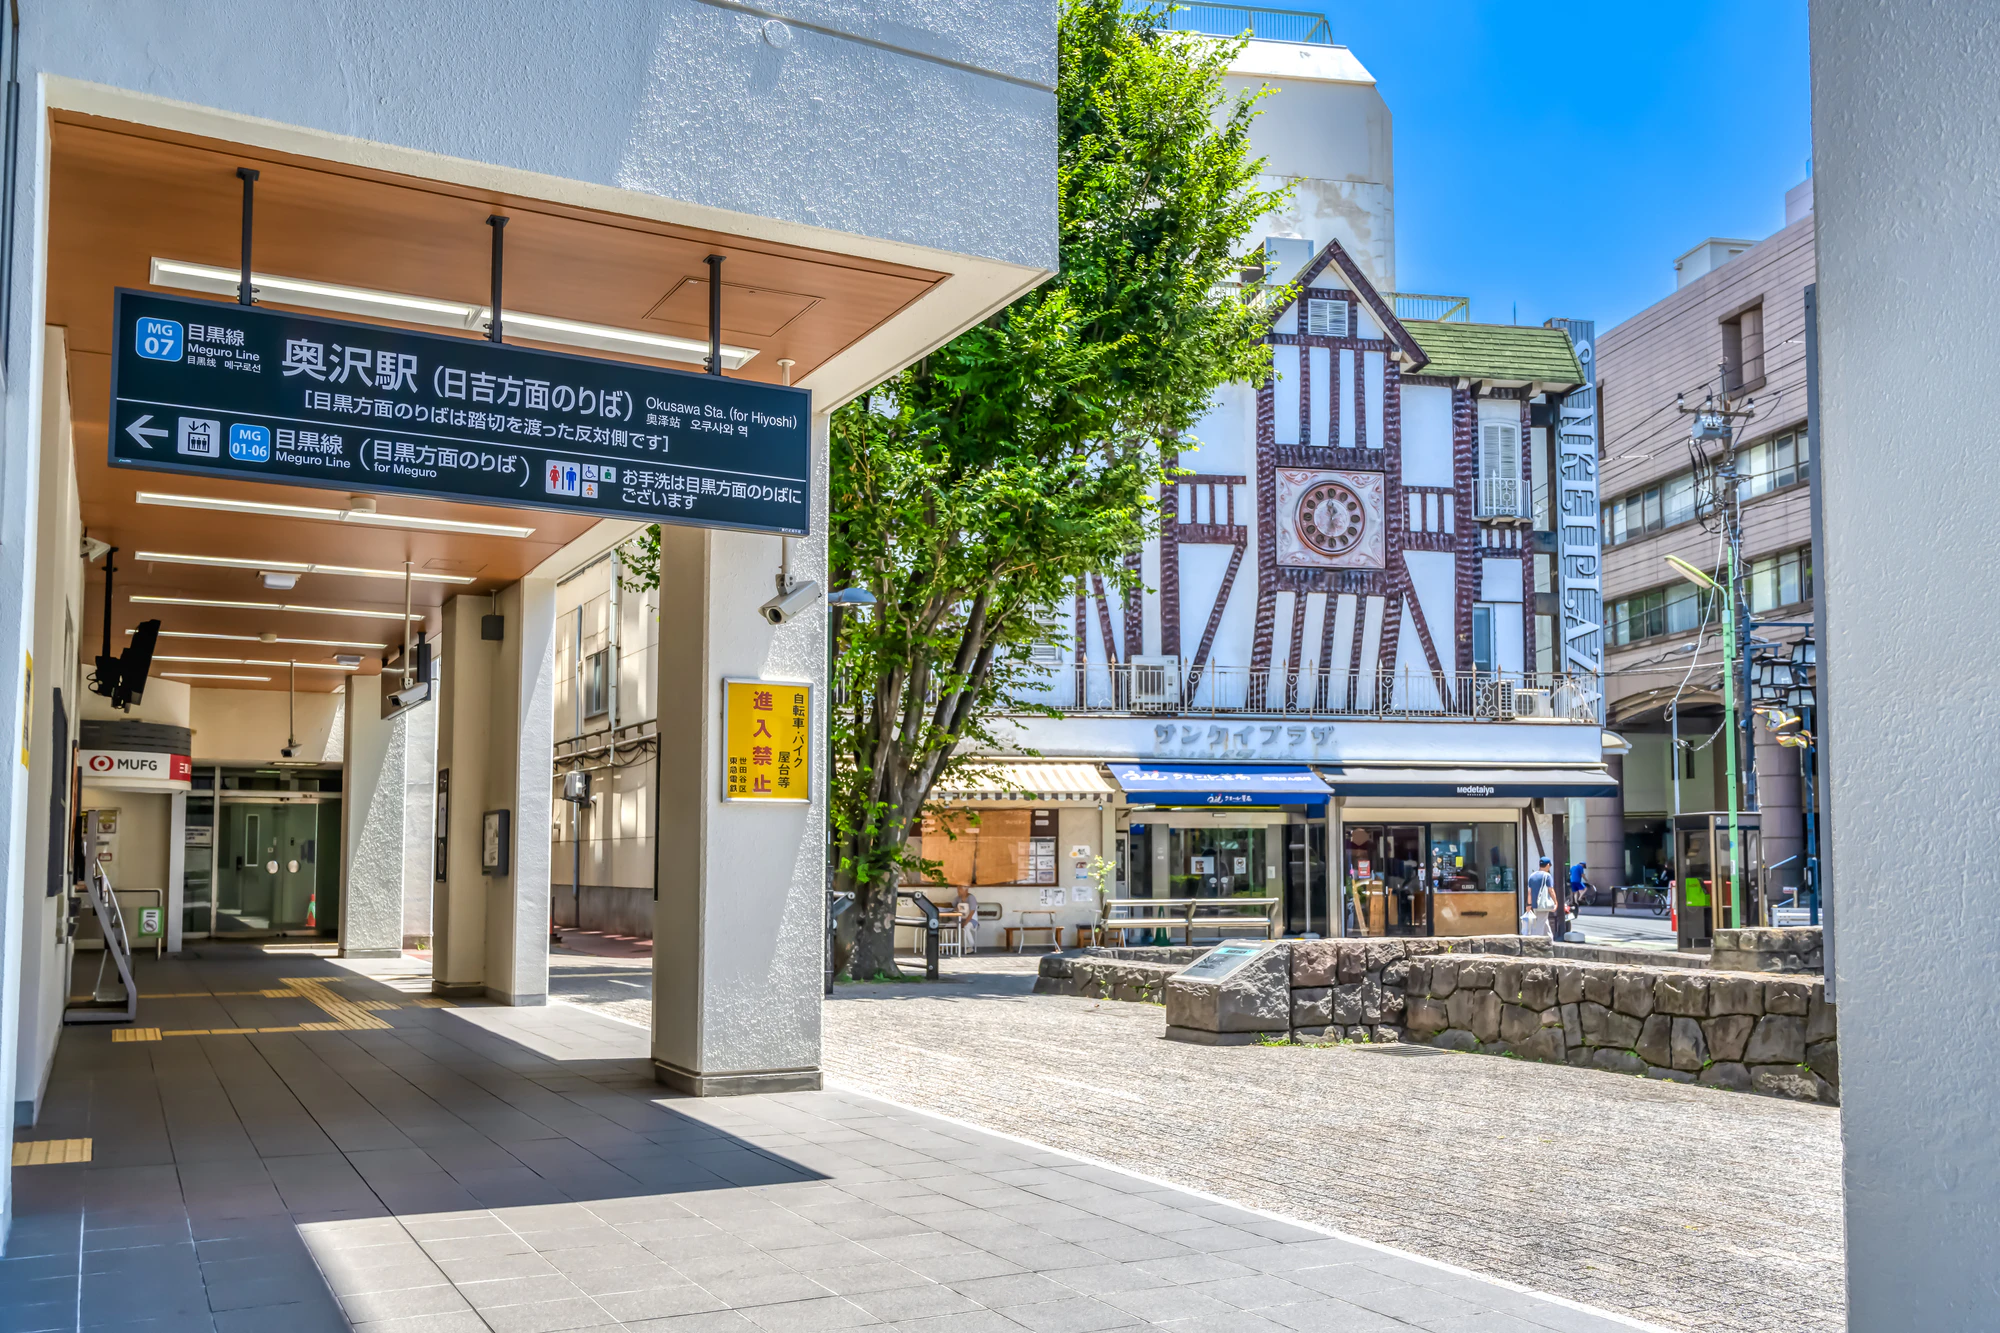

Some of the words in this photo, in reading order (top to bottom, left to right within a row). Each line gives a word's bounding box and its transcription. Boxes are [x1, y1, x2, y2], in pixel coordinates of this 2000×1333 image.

[147, 321, 174, 337] MG
[188, 323, 245, 347] 目黒線
[143, 336, 175, 357] 07
[188, 343, 233, 358] Meguro
[235, 348, 260, 362] Line
[224, 360, 261, 374] 메구로선
[282, 338, 418, 394] 奥沢駅
[433, 365, 633, 422] (日吉方面のりば)
[304, 389, 669, 453] [目黒方面のりばは踏切を渡った反対側です]
[646, 396, 701, 417] Okusawa
[704, 404, 727, 419] Sta.
[729, 406, 749, 422] (for
[751, 411, 797, 430] Hiyoshi)
[239, 429, 262, 442] MG
[690, 419, 734, 436] 오쿠사와
[737, 426, 748, 438] 역
[1560, 340, 1597, 530] SNKEI
[232, 442, 268, 458] 01-06
[275, 428, 344, 455] 目黒線
[275, 451, 322, 466] Meguro
[325, 456, 351, 469] Line
[373, 462, 391, 473] for
[393, 464, 438, 478] Meguro
[622, 469, 802, 504] お手洗は目黒方面のりばに
[622, 488, 698, 510] ございます
[752, 690, 773, 793] 進入禁止
[792, 693, 806, 768] 自転車・バイク
[1154, 723, 1336, 747] サンケイプラザ
[117, 758, 158, 771] MUFG
[729, 757, 738, 793] 東急電鉄
[739, 757, 748, 793] 世田谷区
[777, 751, 791, 788] 屋台等
